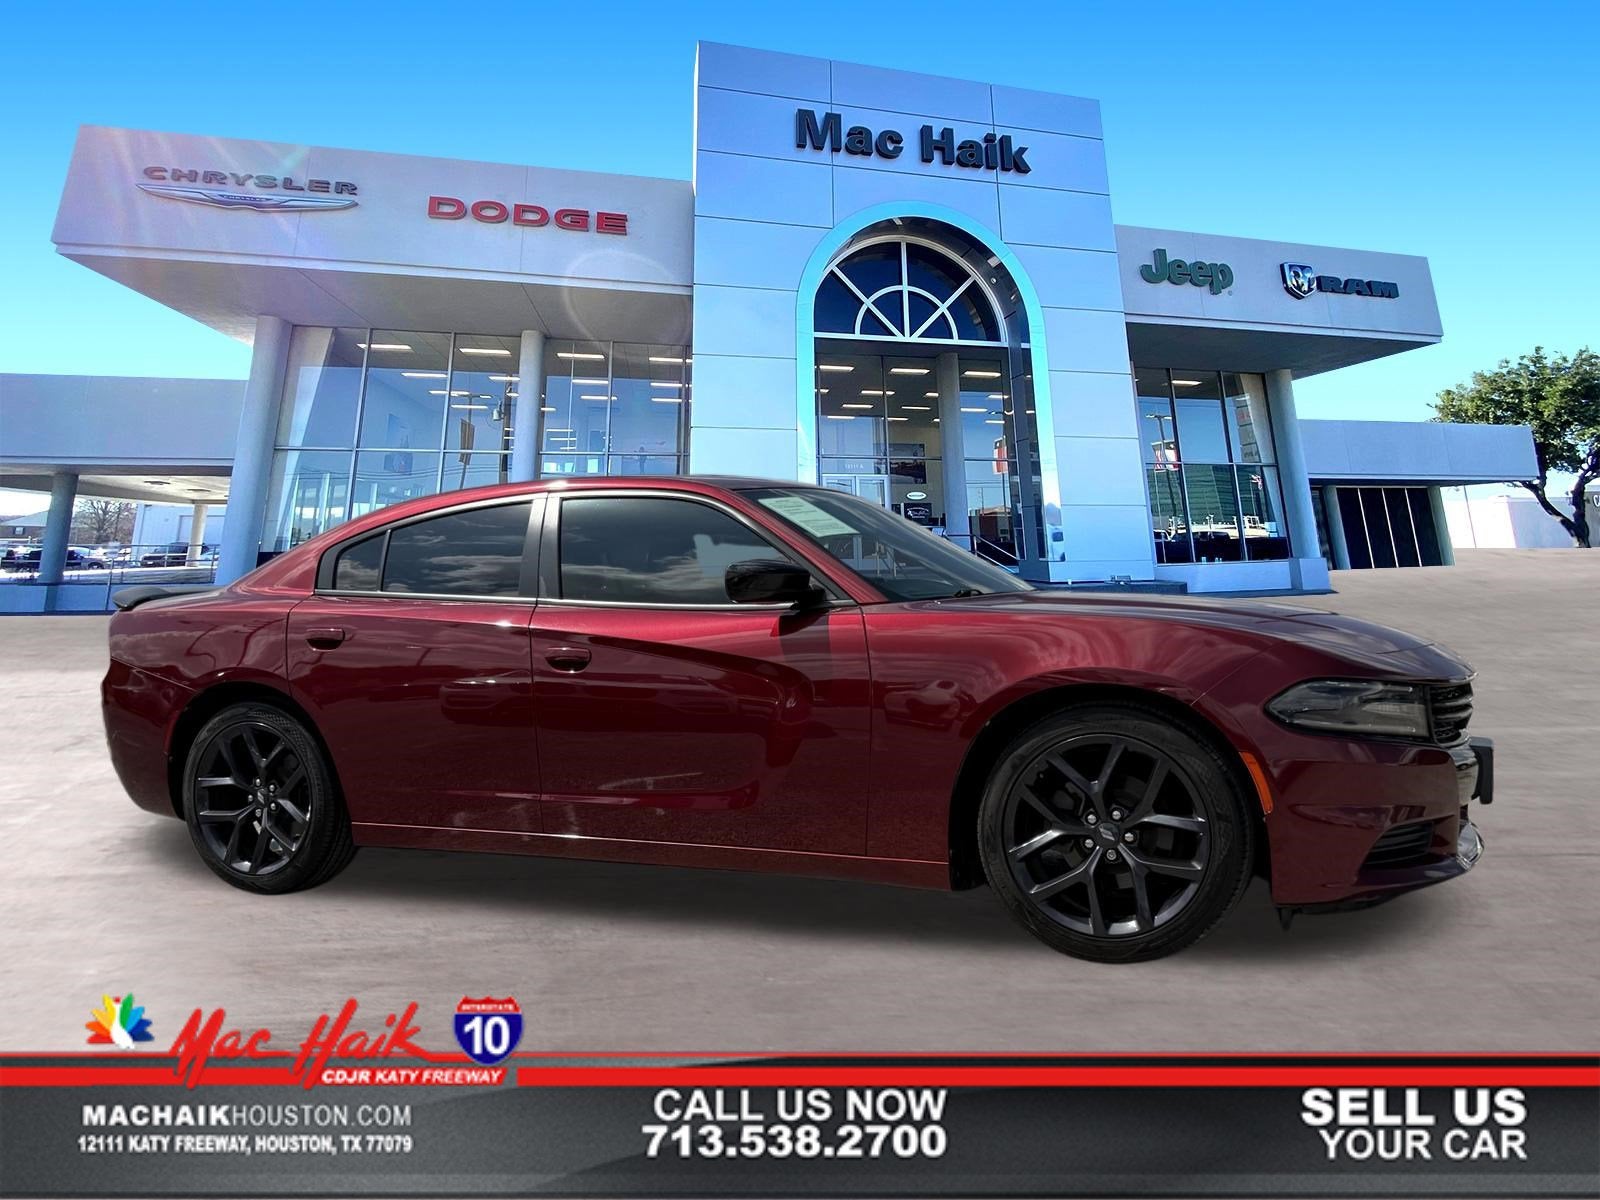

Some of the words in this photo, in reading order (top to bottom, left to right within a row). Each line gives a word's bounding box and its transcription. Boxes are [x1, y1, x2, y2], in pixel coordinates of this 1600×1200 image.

[796, 108, 904, 160] Mac
[920, 124, 1032, 174] Haik
[143, 166, 359, 196] CHRYSLER
[428, 195, 628, 236] DODGE
[1140, 248, 1234, 296] Jeep
[1317, 275, 1399, 299] RAM
